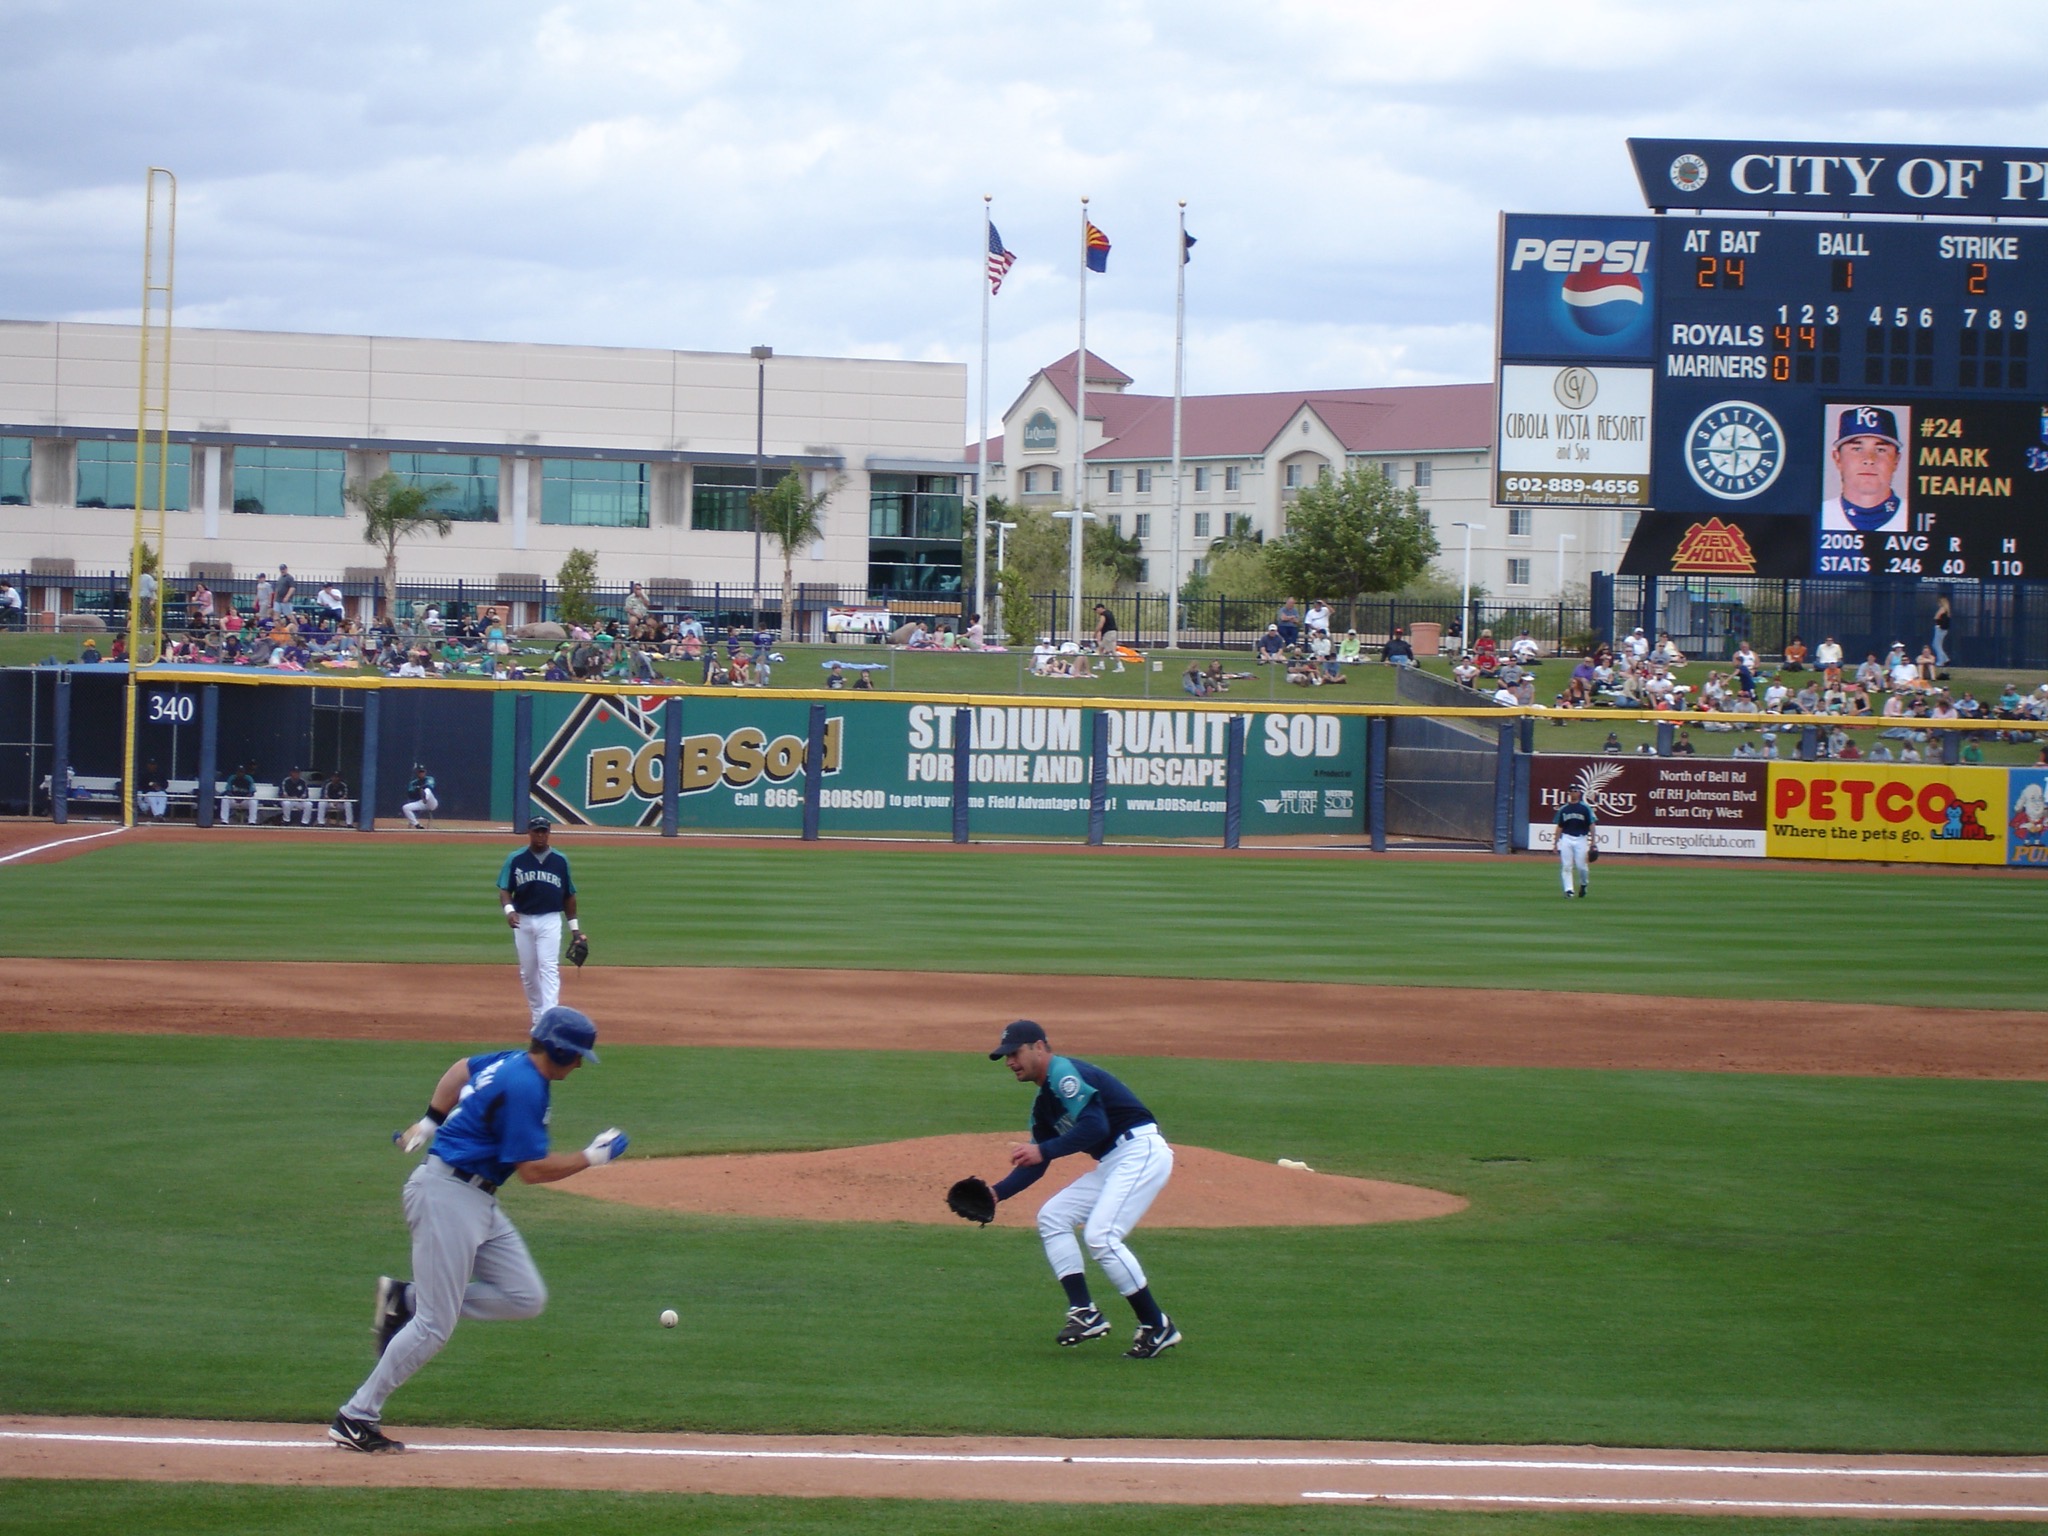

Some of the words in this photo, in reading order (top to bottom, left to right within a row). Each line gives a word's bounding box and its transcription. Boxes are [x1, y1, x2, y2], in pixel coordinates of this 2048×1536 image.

[1730, 154, 1885, 196] CITY
[1898, 158, 1983, 198] OF
[1684, 229, 1711, 252] AT
[1720, 230, 1761, 253] BAT
[1817, 232, 1870, 256] BALL
[1939, 235, 2019, 260] STRIKE
[1510, 238, 1651, 273] PEPSI
[1698, 256, 1745, 287] 24
[1846, 261, 1853, 289] 1
[1968, 262, 1988, 294] 2
[1777, 304, 1788, 324] 1
[1801, 304, 1814, 324] 2
[1825, 305, 1840, 325] 3
[1869, 305, 1883, 326] 4
[1895, 307, 1909, 327] 5
[1919, 307, 1934, 328] 6
[1963, 308, 1978, 328] 7
[1988, 309, 2002, 329] 8
[2014, 309, 2028, 330] 9
[1672, 323, 1765, 346] ROYALS
[1774, 326, 1790, 348] 4
[1800, 326, 1815, 349] 4
[1667, 354, 1768, 379] MARINERS
[1773, 355, 1790, 381] 0
[1505, 412, 1549, 440] CIBOLA
[1555, 413, 1591, 441] VISTA
[1597, 414, 1646, 442] RESORT
[1697, 409, 1774, 440] SEATTLE
[1920, 418, 1963, 438] #24
[1556, 443, 1571, 460] and
[1574, 442, 1590, 463] Spa
[1918, 447, 1990, 468] MARK
[1696, 458, 1774, 490] MARINERS
[1505, 477, 1640, 494] 602-889-4656
[1917, 475, 2012, 497] TEAHAN
[1505, 492, 1520, 502] For
[1544, 493, 1581, 504] Personal
[1916, 513, 1936, 532] IF
[1700, 534, 1732, 548] RED
[1820, 533, 1865, 550] 2005
[1884, 535, 1929, 551] AVG
[1949, 536, 1961, 552] R
[2003, 538, 2017, 554] H
[1686, 548, 1741, 563] HOOK
[1820, 555, 1872, 573] STATS
[1884, 557, 1923, 574] .246
[1942, 558, 1966, 575] 60
[1991, 560, 2023, 576] 110
[149, 695, 194, 722] 340
[1263, 713, 1341, 757] SOD
[908, 753, 955, 782] FOR
[1032, 755, 1083, 784] AND
[1088, 756, 1227, 787] ANDSCAPE
[1660, 770, 1692, 782] North
[1694, 771, 1706, 782] of
[1708, 771, 1729, 783] Bell
[1731, 772, 1747, 783] Rd
[734, 792, 759, 806] Call
[889, 794, 901, 807] to
[902, 794, 922, 809] get
[923, 796, 950, 808] your
[988, 795, 1016, 809] Field
[1017, 796, 1077, 811] Advantage
[1127, 798, 1228, 813] www.BOBSod.com
[1281, 798, 1318, 814] TURF
[1324, 796, 1354, 809] SOD
[1649, 788, 1667, 799] off
[1667, 789, 1683, 800] RH
[1685, 790, 1731, 802] Johnson
[1732, 790, 1757, 802] Blvd
[1774, 778, 1957, 824] PETCO
[1655, 806, 1667, 817] in
[1668, 807, 1689, 818] Sun
[1691, 806, 1712, 820] City
[1716, 807, 1744, 819] West
[1629, 832, 1756, 850] hillcrestgolfclub.com
[1773, 824, 1827, 838] Where
[1831, 825, 1857, 839] the
[1862, 827, 1897, 842] pets
[1901, 829, 1925, 844] go.
